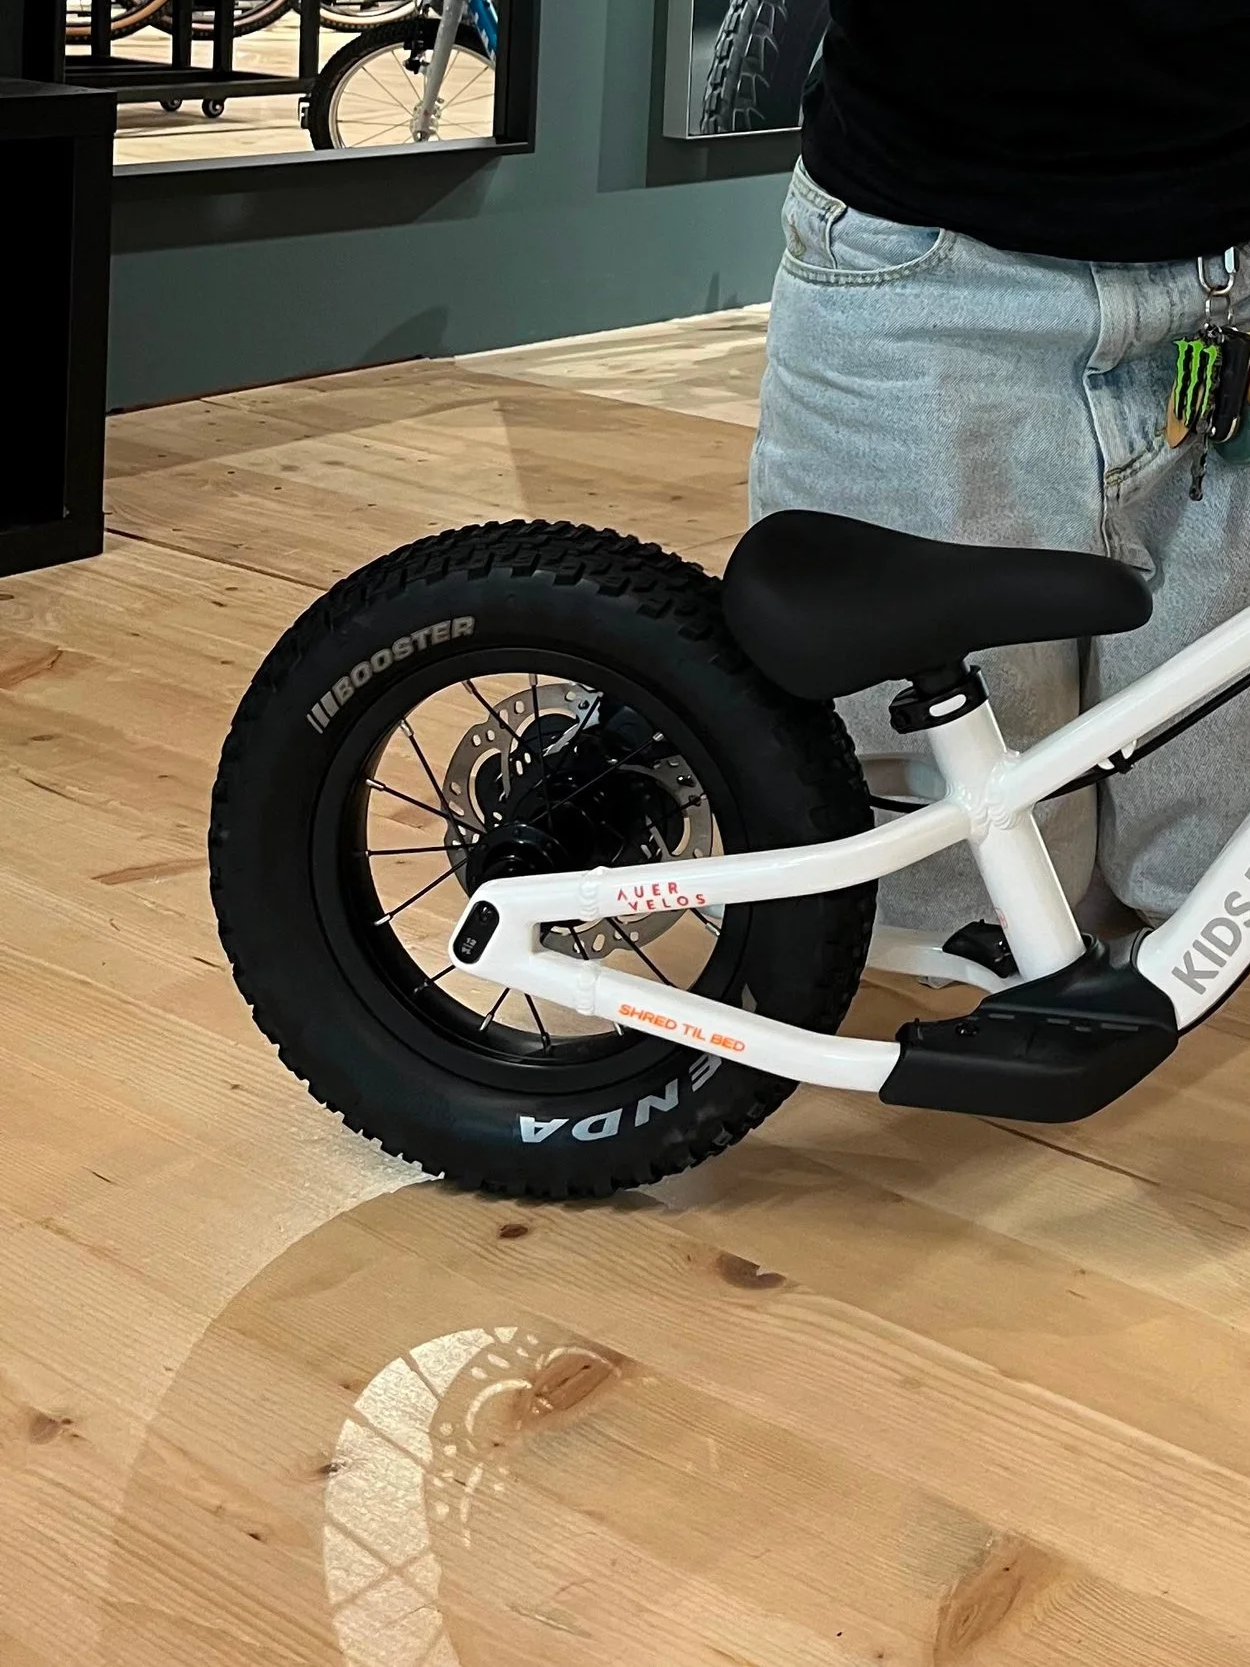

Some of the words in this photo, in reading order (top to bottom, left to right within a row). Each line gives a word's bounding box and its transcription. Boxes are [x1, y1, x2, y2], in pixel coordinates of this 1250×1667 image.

[332, 616, 476, 706] BOOSTER
[617, 881, 679, 901] AUER
[628, 894, 706, 911] VELOS
[618, 1004, 677, 1031] SHRED
[682, 1023, 706, 1042] TIL
[710, 1034, 746, 1053] BED
[519, 1053, 722, 1143] ENDA
